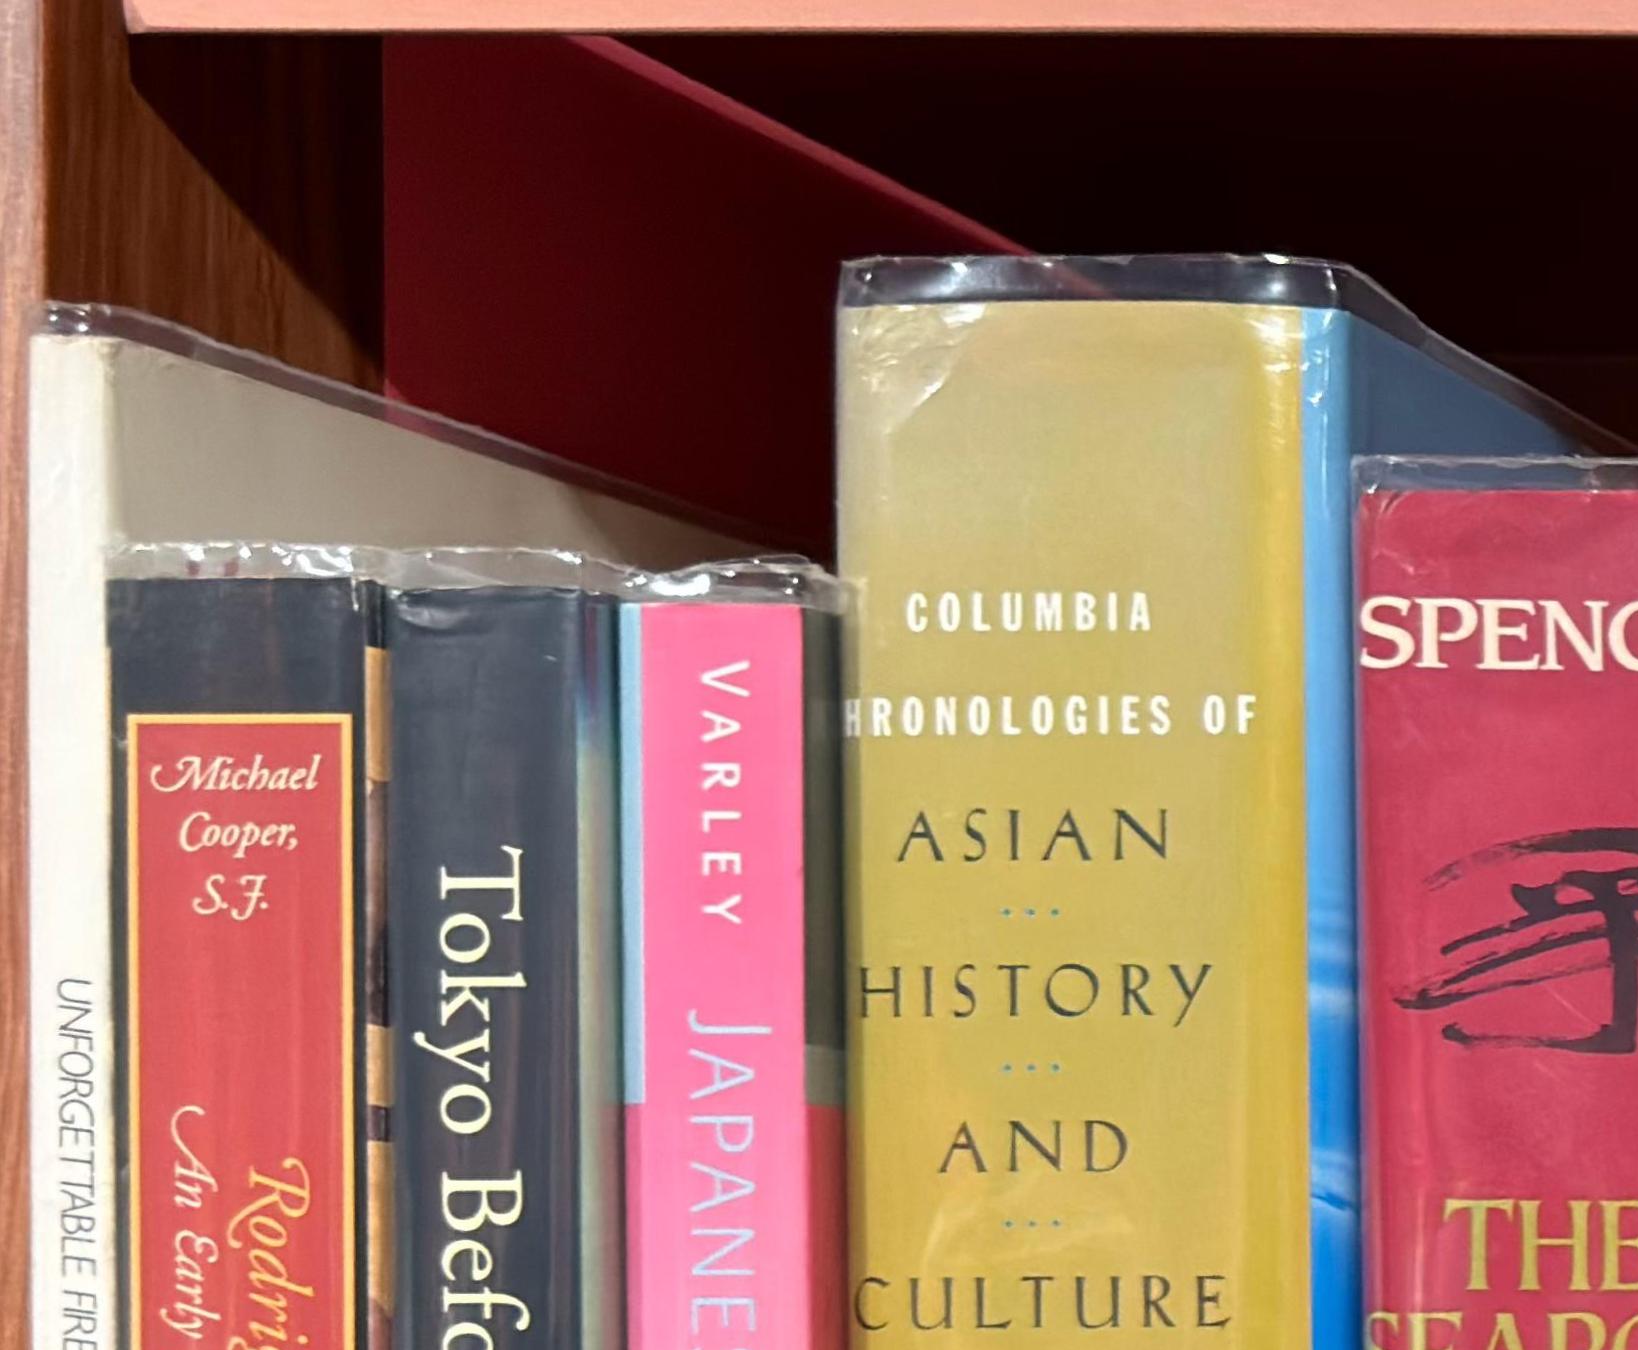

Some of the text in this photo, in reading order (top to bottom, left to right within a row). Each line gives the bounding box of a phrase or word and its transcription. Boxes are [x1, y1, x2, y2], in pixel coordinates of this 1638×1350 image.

[906, 592, 1152, 632] COLUMBIA
[1203, 695, 1257, 735] OF
[149, 753, 320, 792] Michael
[697, 659, 751, 927] VARLEY
[178, 813, 299, 851] Cooper,
[896, 808, 1169, 863] ASIAN
[412, 844, 525, 1136] Tokyo
[859, 962, 1213, 1028] HISTORY
[57, 977, 97, 1278] UNFORGETTABLE
[938, 1120, 1129, 1174] AND
[171, 1105, 219, 1209] An
[160, 1229, 221, 1340] Early
[853, 1275, 1233, 1331] CULTURE
